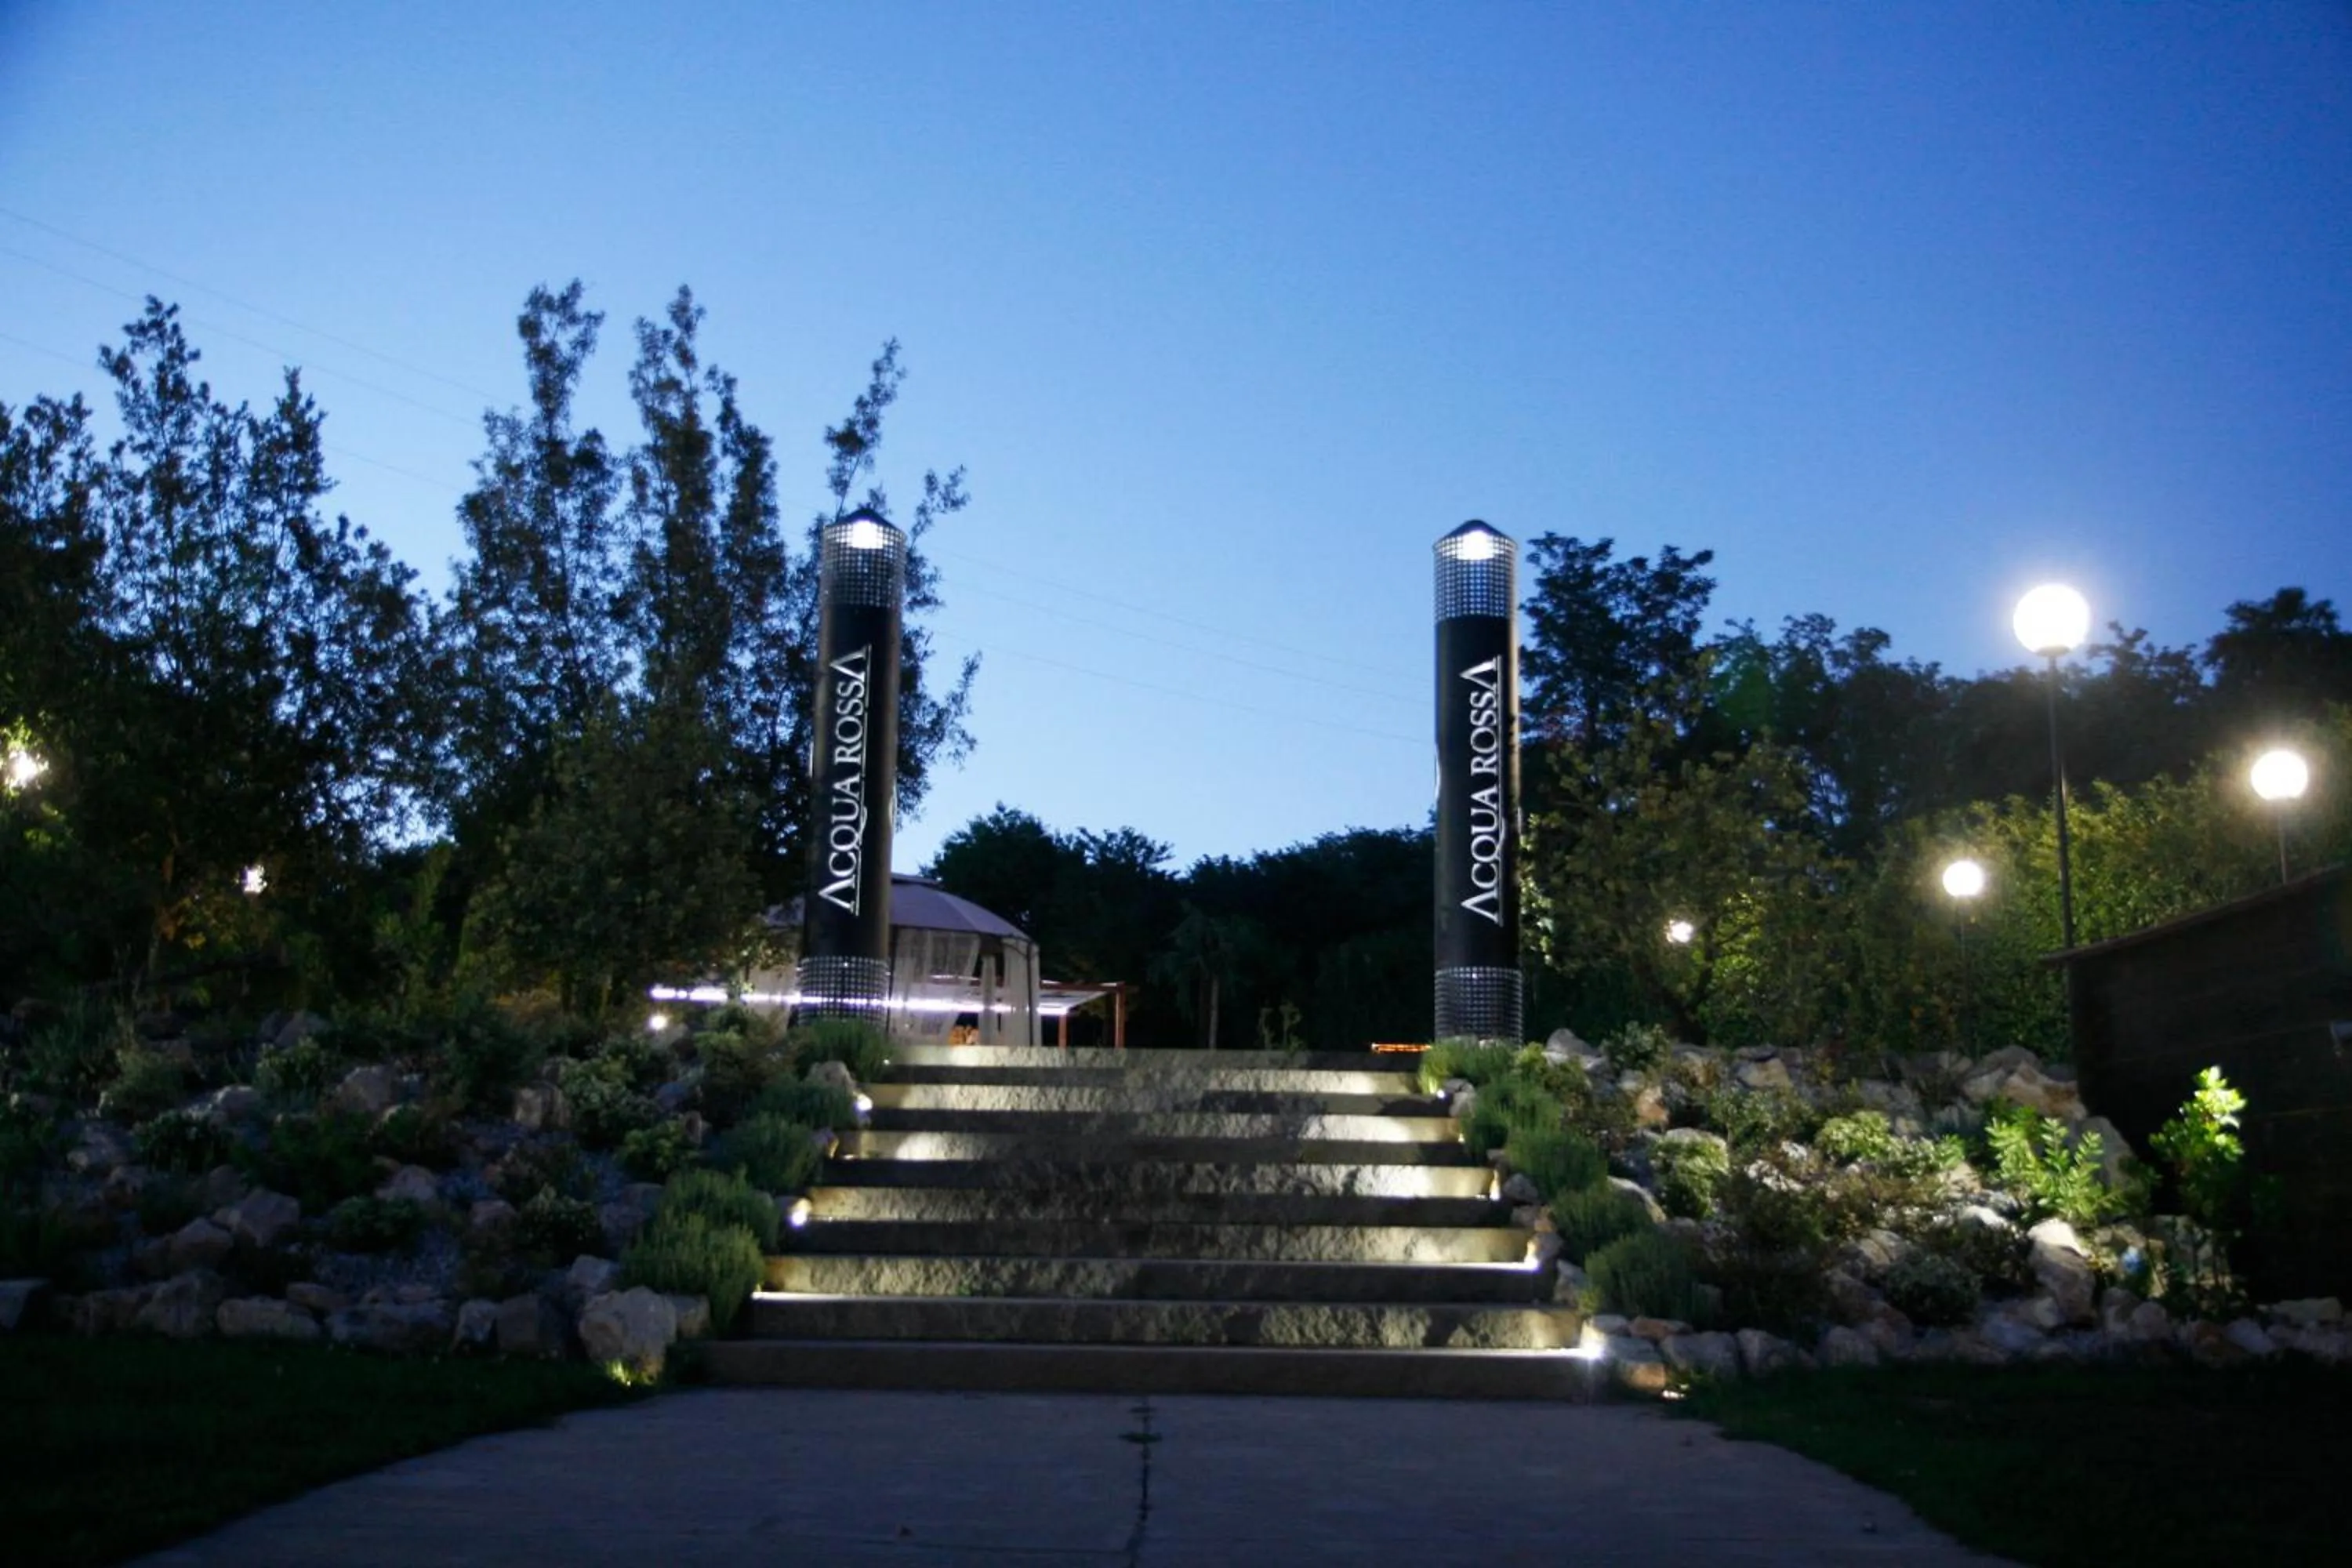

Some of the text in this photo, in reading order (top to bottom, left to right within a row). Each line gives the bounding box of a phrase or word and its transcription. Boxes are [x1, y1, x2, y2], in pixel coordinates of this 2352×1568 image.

[818, 645, 869, 915] ACQUA ROSSA
[1460, 656, 1505, 924] ACQUA ROSSA
